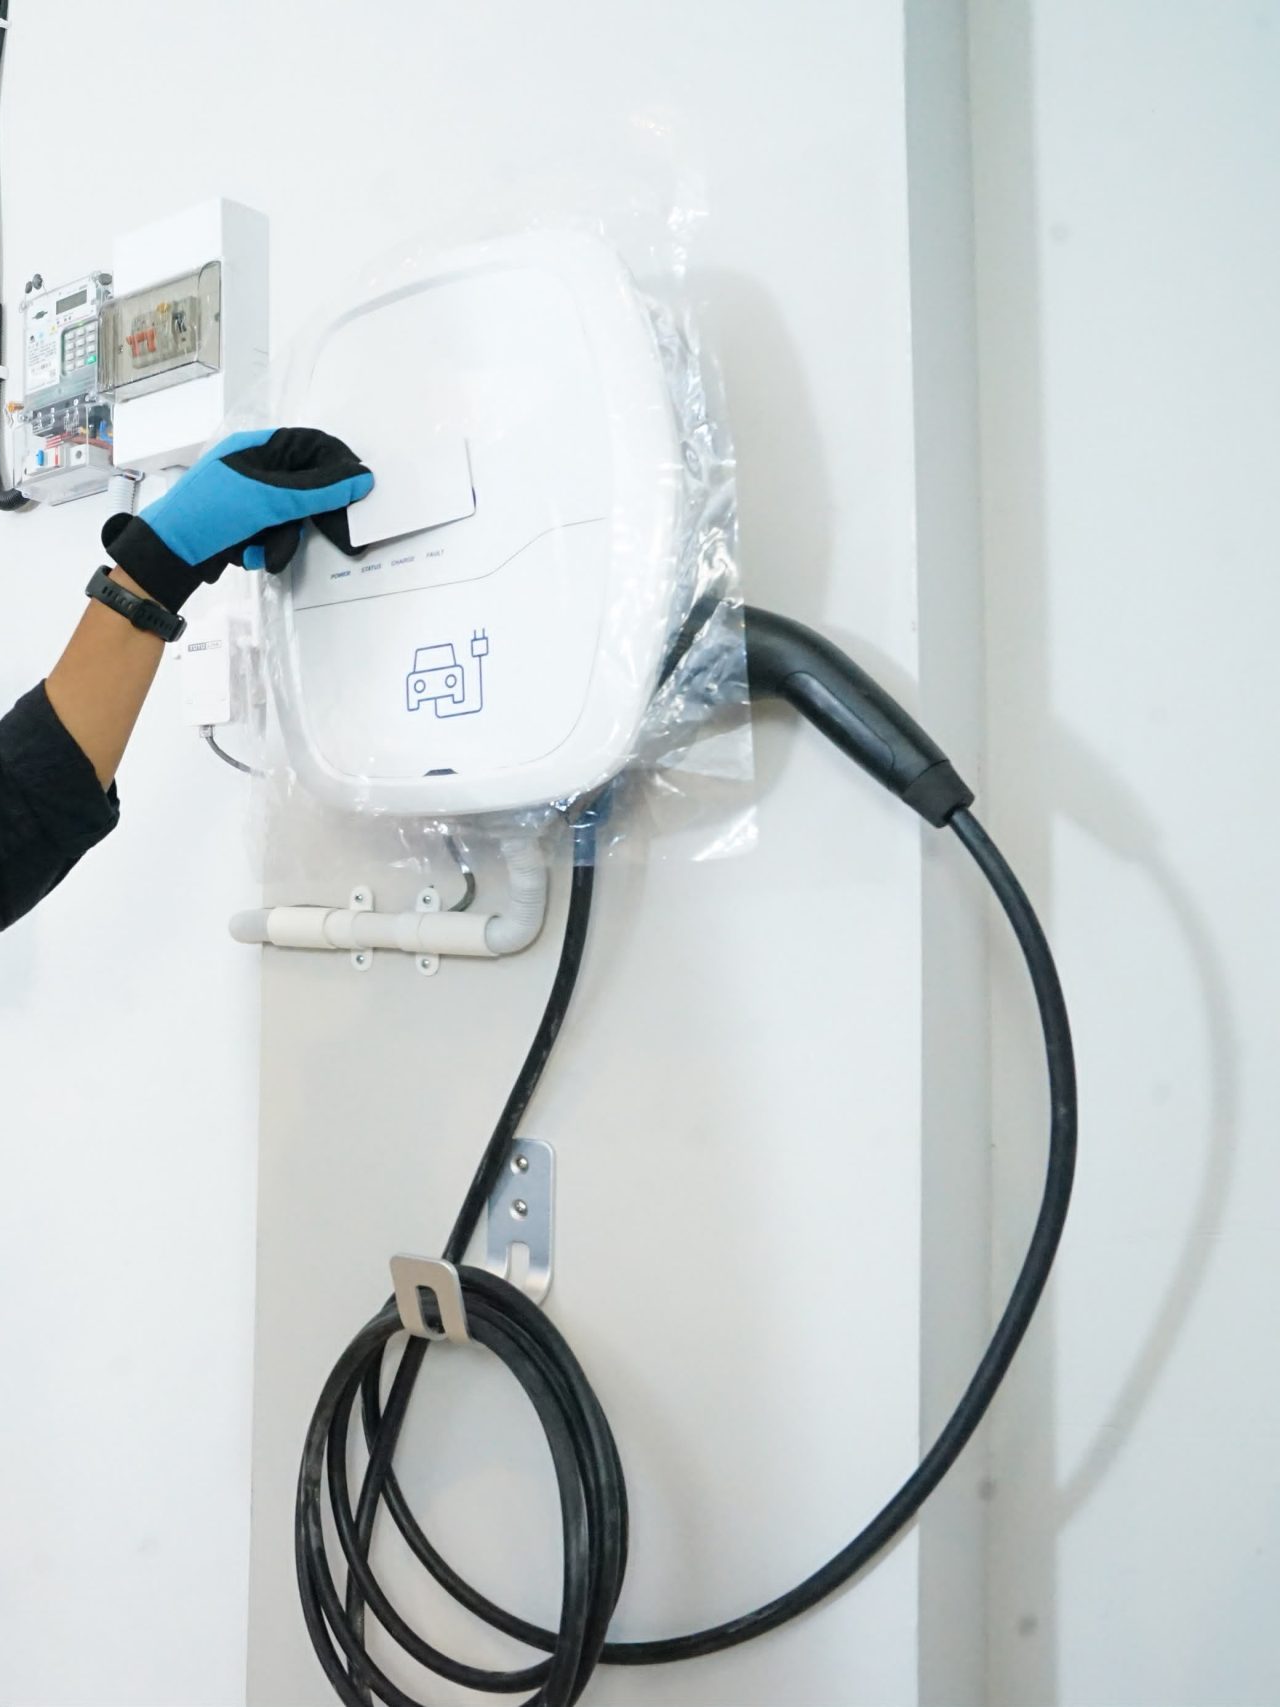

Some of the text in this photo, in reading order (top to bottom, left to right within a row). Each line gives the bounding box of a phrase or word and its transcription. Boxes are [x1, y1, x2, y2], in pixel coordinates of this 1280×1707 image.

[330, 549, 444, 580] POWER STATUS CHARGE FAULT
